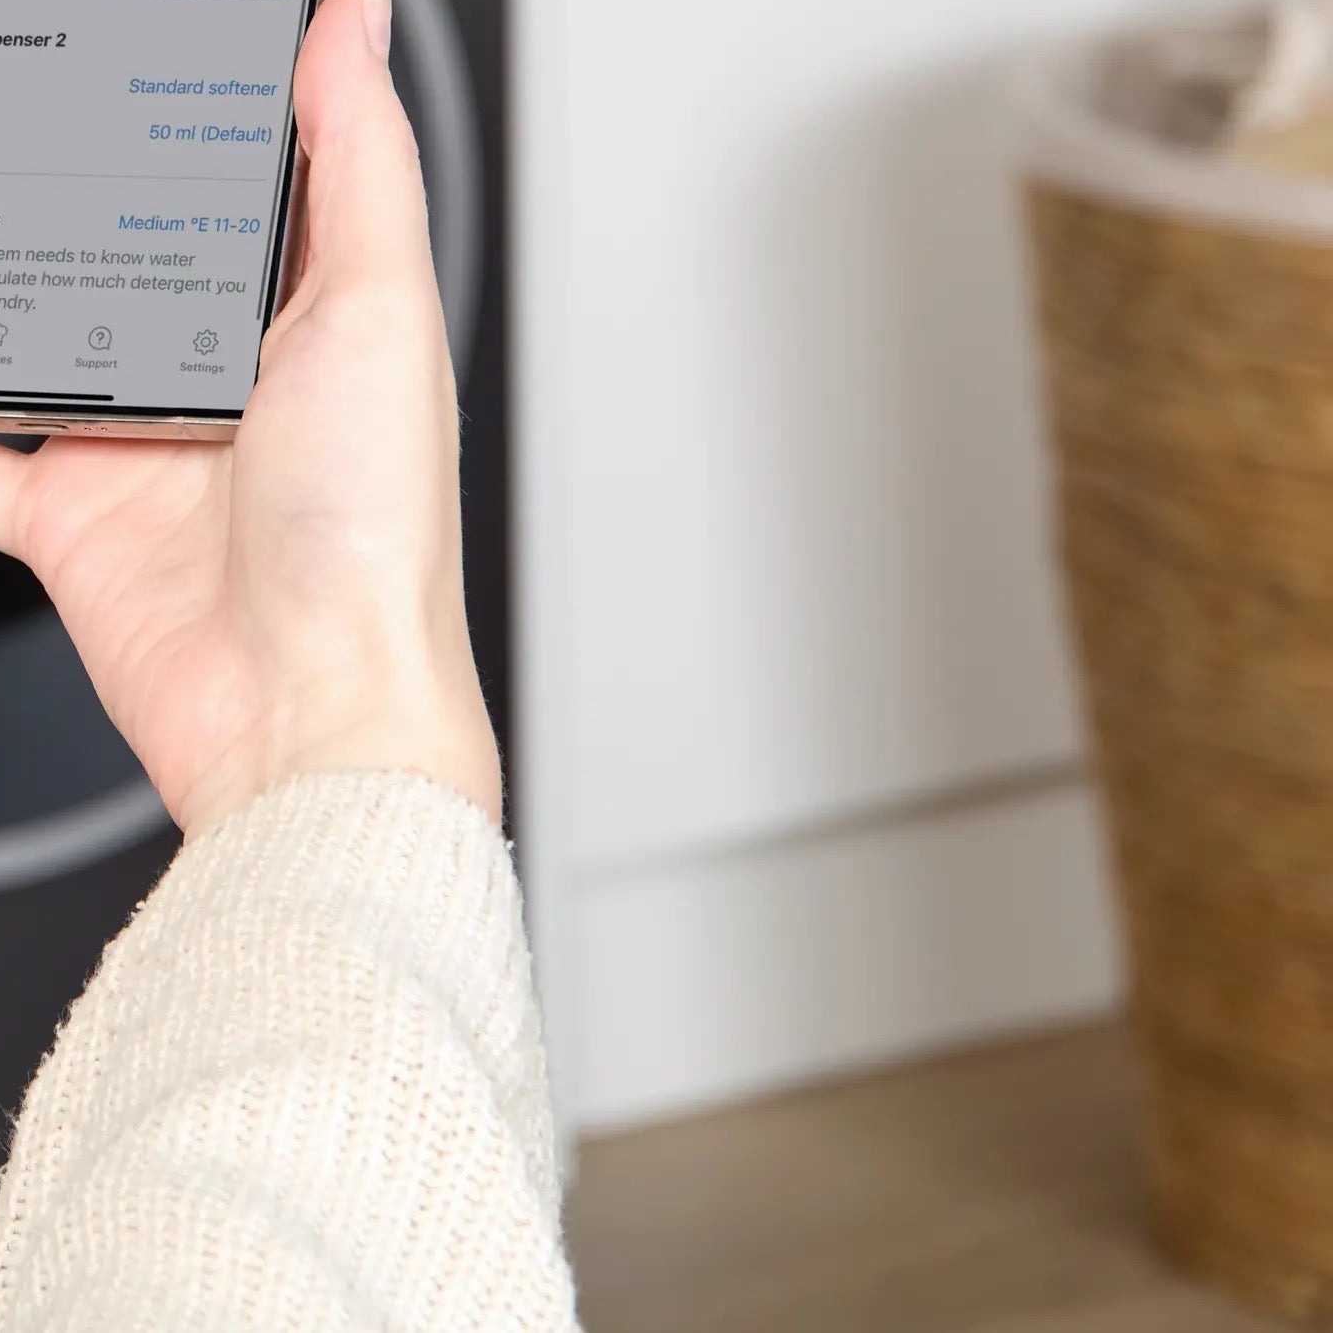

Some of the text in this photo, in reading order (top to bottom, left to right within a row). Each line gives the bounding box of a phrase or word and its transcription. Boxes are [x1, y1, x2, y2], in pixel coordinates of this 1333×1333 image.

[55, 33, 66, 47] 2
[129, 78, 204, 94] Standard
[209, 80, 278, 96] softener
[150, 125, 171, 140] 50
[176, 125, 196, 140] ml
[202, 126, 272, 145] (Default)
[119, 215, 184, 231] Medium
[215, 218, 260, 234] 11-20
[25, 248, 75, 263] needs
[81, 250, 96, 263] to
[101, 249, 145, 265] know
[150, 253, 196, 267] water
[41, 271, 76, 287] how
[80, 274, 125, 288] much
[130, 275, 212, 294] detergent
[216, 281, 246, 295] you
[75, 358, 117, 370] Support
[180, 362, 224, 374] Settings
